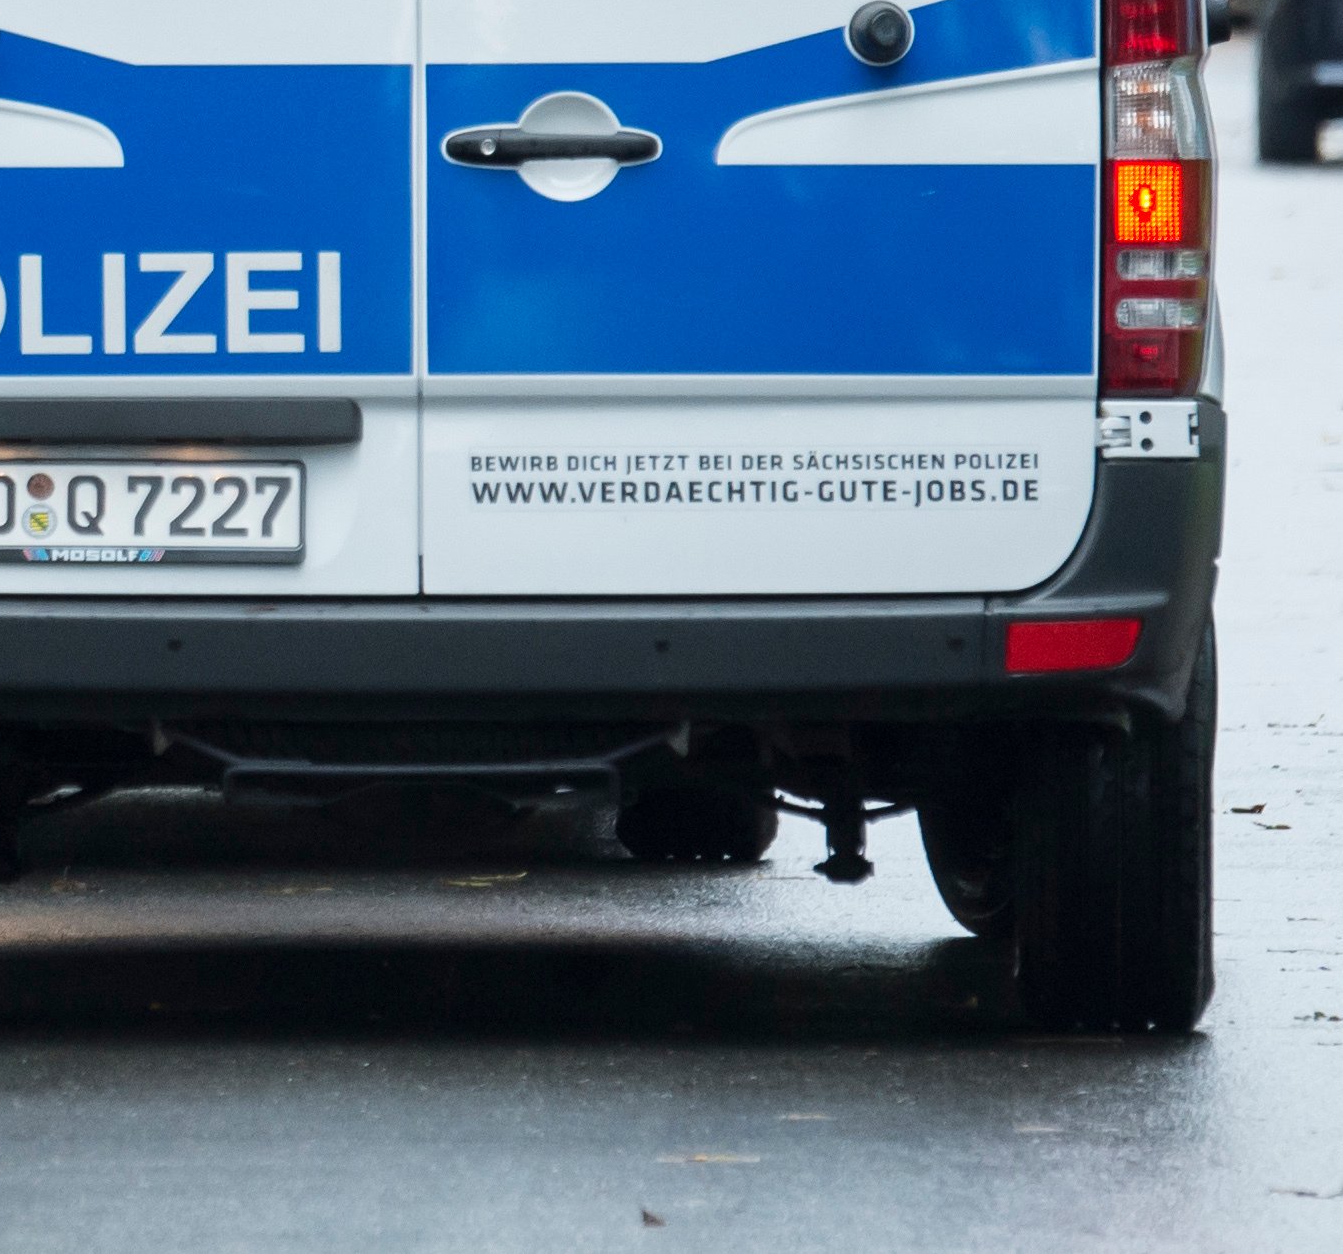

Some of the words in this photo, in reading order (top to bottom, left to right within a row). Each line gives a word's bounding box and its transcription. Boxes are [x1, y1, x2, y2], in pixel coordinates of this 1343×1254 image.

[470, 455, 558, 472] BEWIRB
[567, 455, 617, 472] DICH
[626, 454, 689, 475] JETZT
[698, 454, 732, 471] BEI
[741, 454, 784, 470] DER
[793, 449, 945, 470] SÄCHSISCHEN
[954, 453, 1039, 470] POLIZEI
[66, 474, 106, 536] Q
[126, 475, 292, 537] 7227
[471, 479, 1040, 508] WWW.VERDAECHTIG-GUTE-JOBS.DE
[51, 549, 140, 562] MOSOLF
